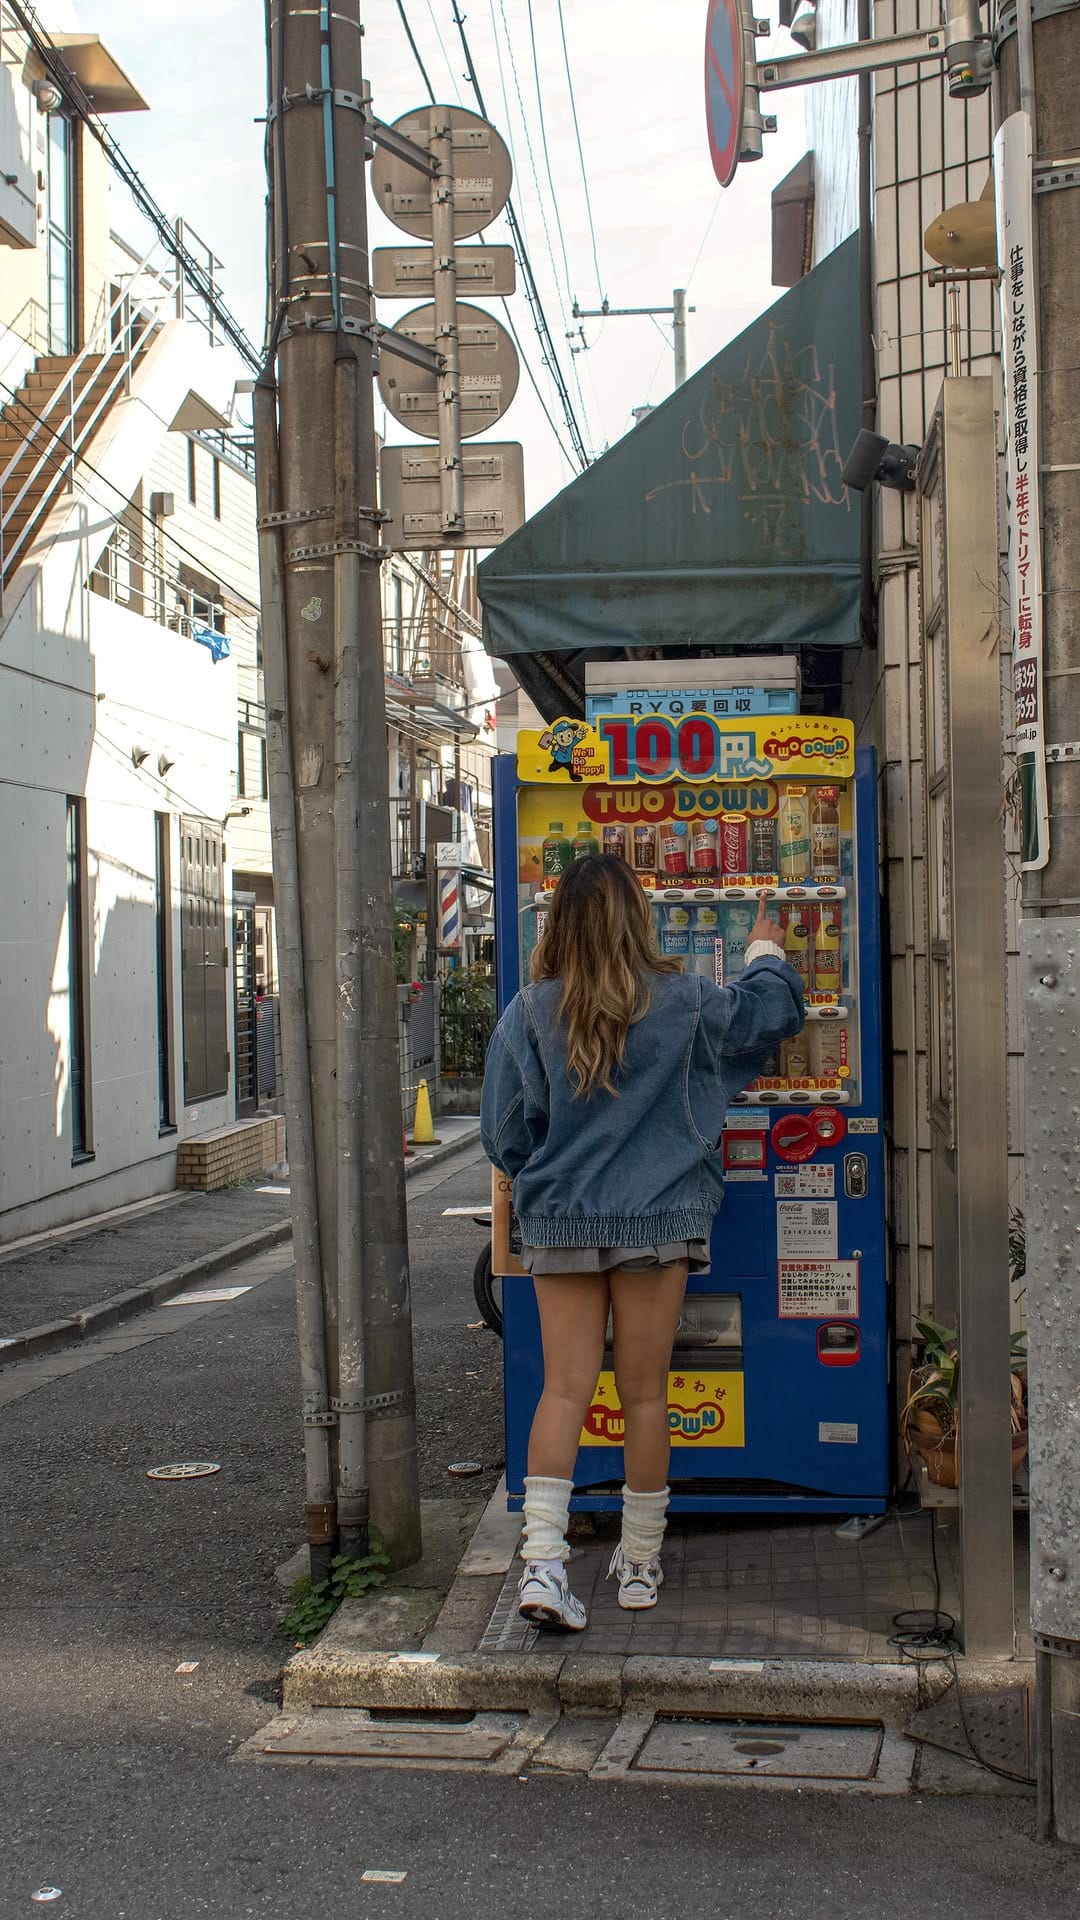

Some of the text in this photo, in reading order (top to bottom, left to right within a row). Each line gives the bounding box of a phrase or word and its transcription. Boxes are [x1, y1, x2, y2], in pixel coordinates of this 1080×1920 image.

[573, 748, 594, 757] We'll
[769, 739, 845, 757] TWO DOWN
[573, 758, 585, 766] Be
[573, 765, 604, 775] Happy!
[596, 788, 768, 813] TWO DOWN
[592, 1410, 716, 1434] TW OWN
